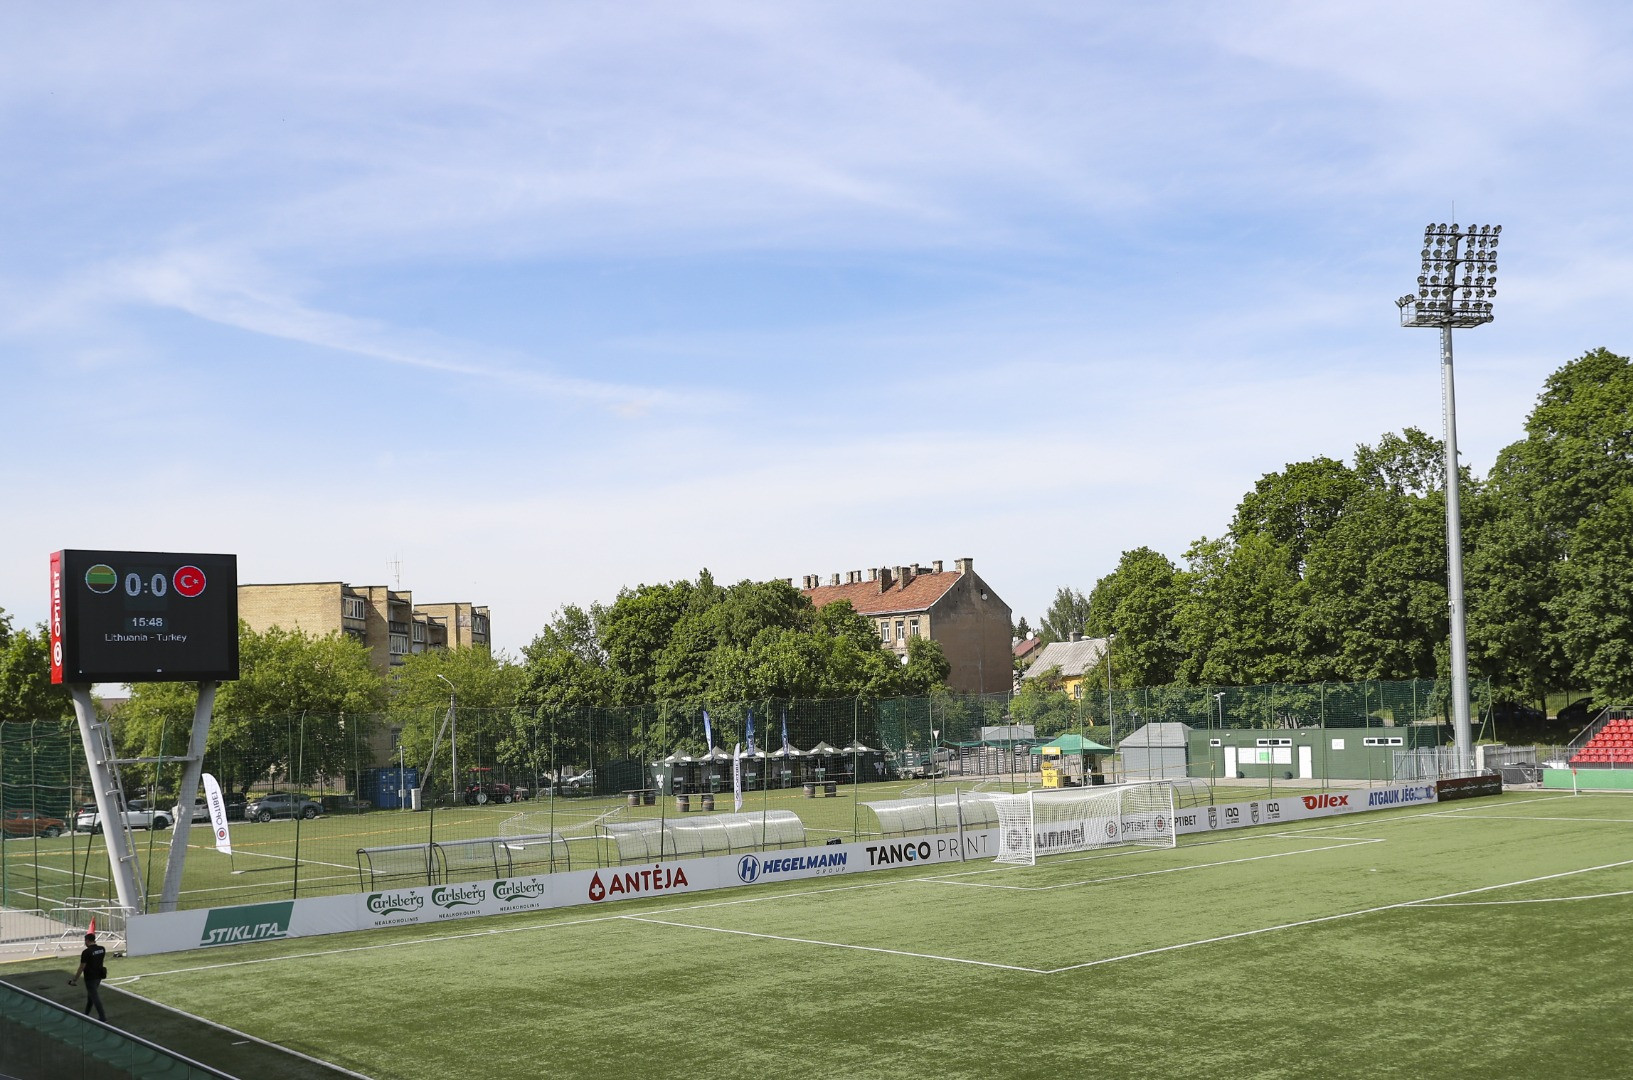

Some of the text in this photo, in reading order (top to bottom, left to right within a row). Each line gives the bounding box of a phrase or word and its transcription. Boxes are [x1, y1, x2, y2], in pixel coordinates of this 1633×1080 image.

[132, 617, 163, 627] 15:48
[105, 633, 148, 642] Lithuania
[157, 633, 187, 643] Turkey
[1368, 784, 1423, 807] ATGAUK JĖG
[866, 834, 988, 866] TANGO PRNT
[762, 852, 848, 874] HEGELMANN
[815, 866, 846, 875] GROUP
[492, 880, 545, 902] Carlsberg
[608, 864, 689, 896] ANTĖJA
[366, 892, 424, 915] Carlsberg
[431, 886, 487, 908] Carlsberg
[201, 922, 287, 944] STIKLITA
